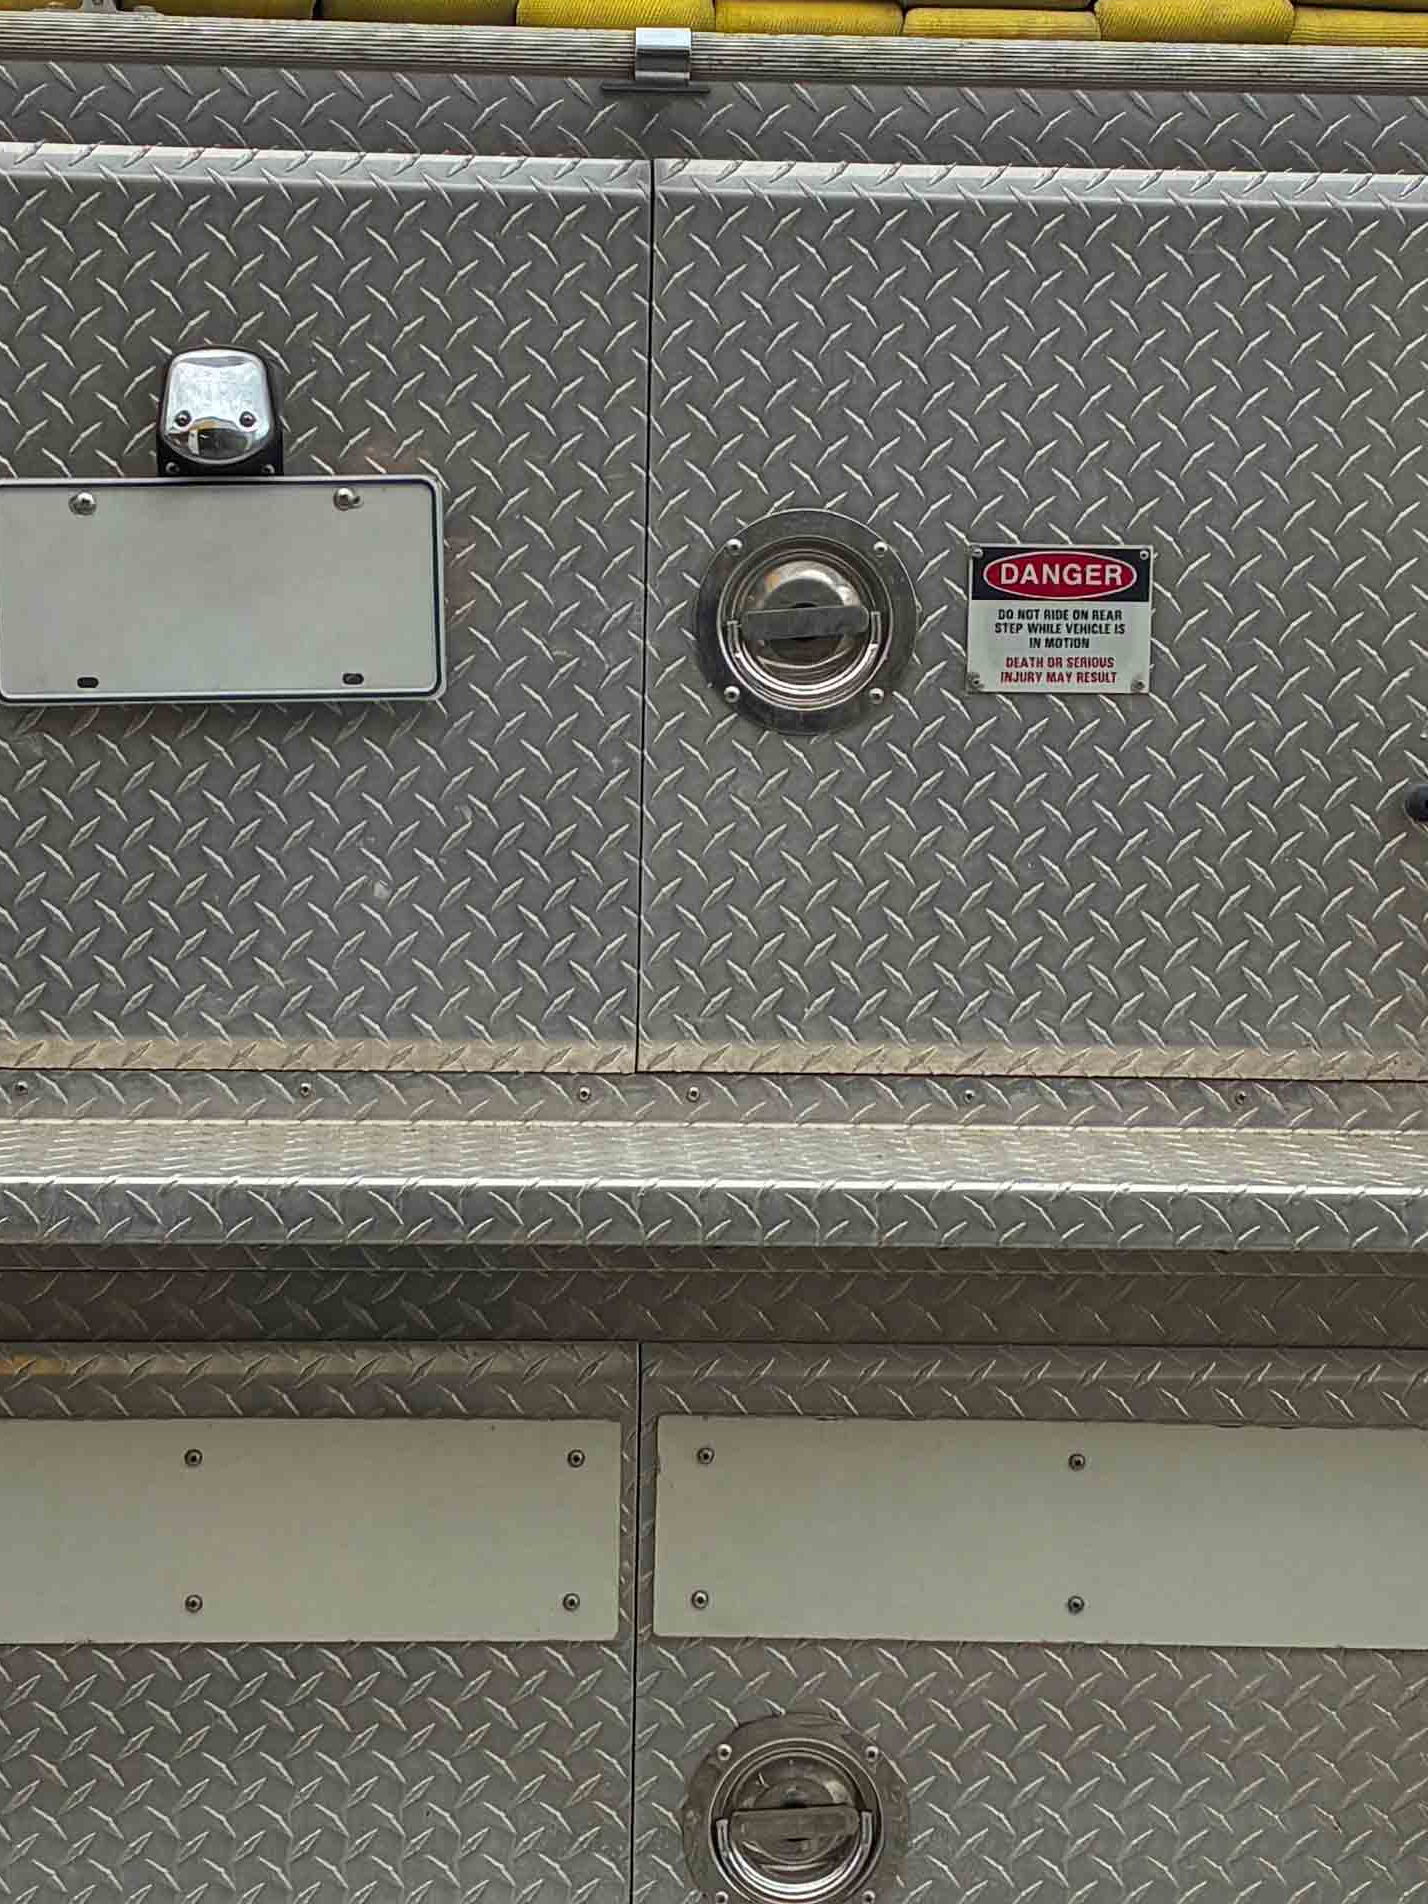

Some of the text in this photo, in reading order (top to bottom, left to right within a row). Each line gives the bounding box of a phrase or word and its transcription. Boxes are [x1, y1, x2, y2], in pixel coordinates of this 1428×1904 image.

[1000, 562, 1123, 586] DANGER
[998, 608, 1123, 621] DO NOT RIDE ON REAR
[994, 622, 1126, 635] STEP WHILE VEHICLE IS
[1029, 637, 1090, 649] IN MOTION
[1005, 656, 1115, 669] DEATH OR SERIOUS
[1000, 671, 1118, 684] INJURY MAY RESULT
